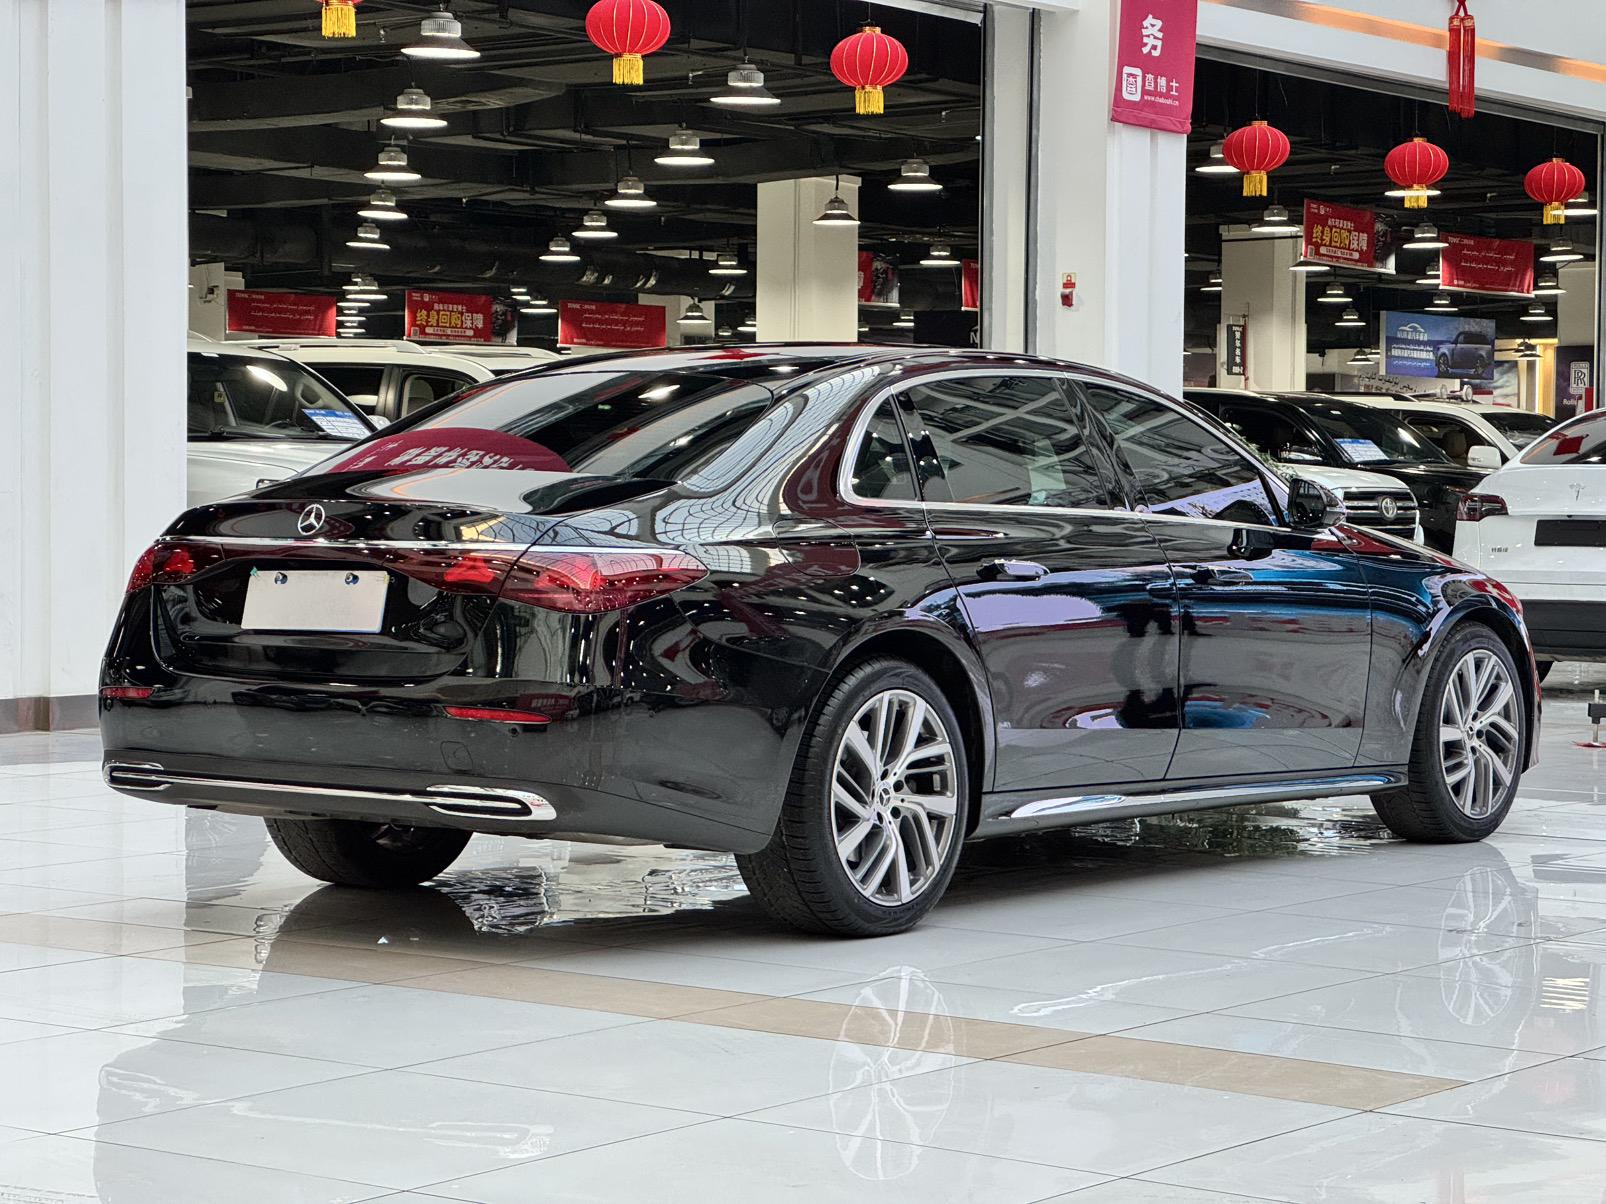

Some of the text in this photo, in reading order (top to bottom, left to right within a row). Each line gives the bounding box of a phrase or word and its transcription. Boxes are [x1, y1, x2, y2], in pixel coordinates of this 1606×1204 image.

[1141, 14, 1163, 57] 务
[1144, 73, 1179, 95] 查博士
[1312, 224, 1368, 252] 终身回购保障
[416, 309, 484, 329] 终身回购保障
